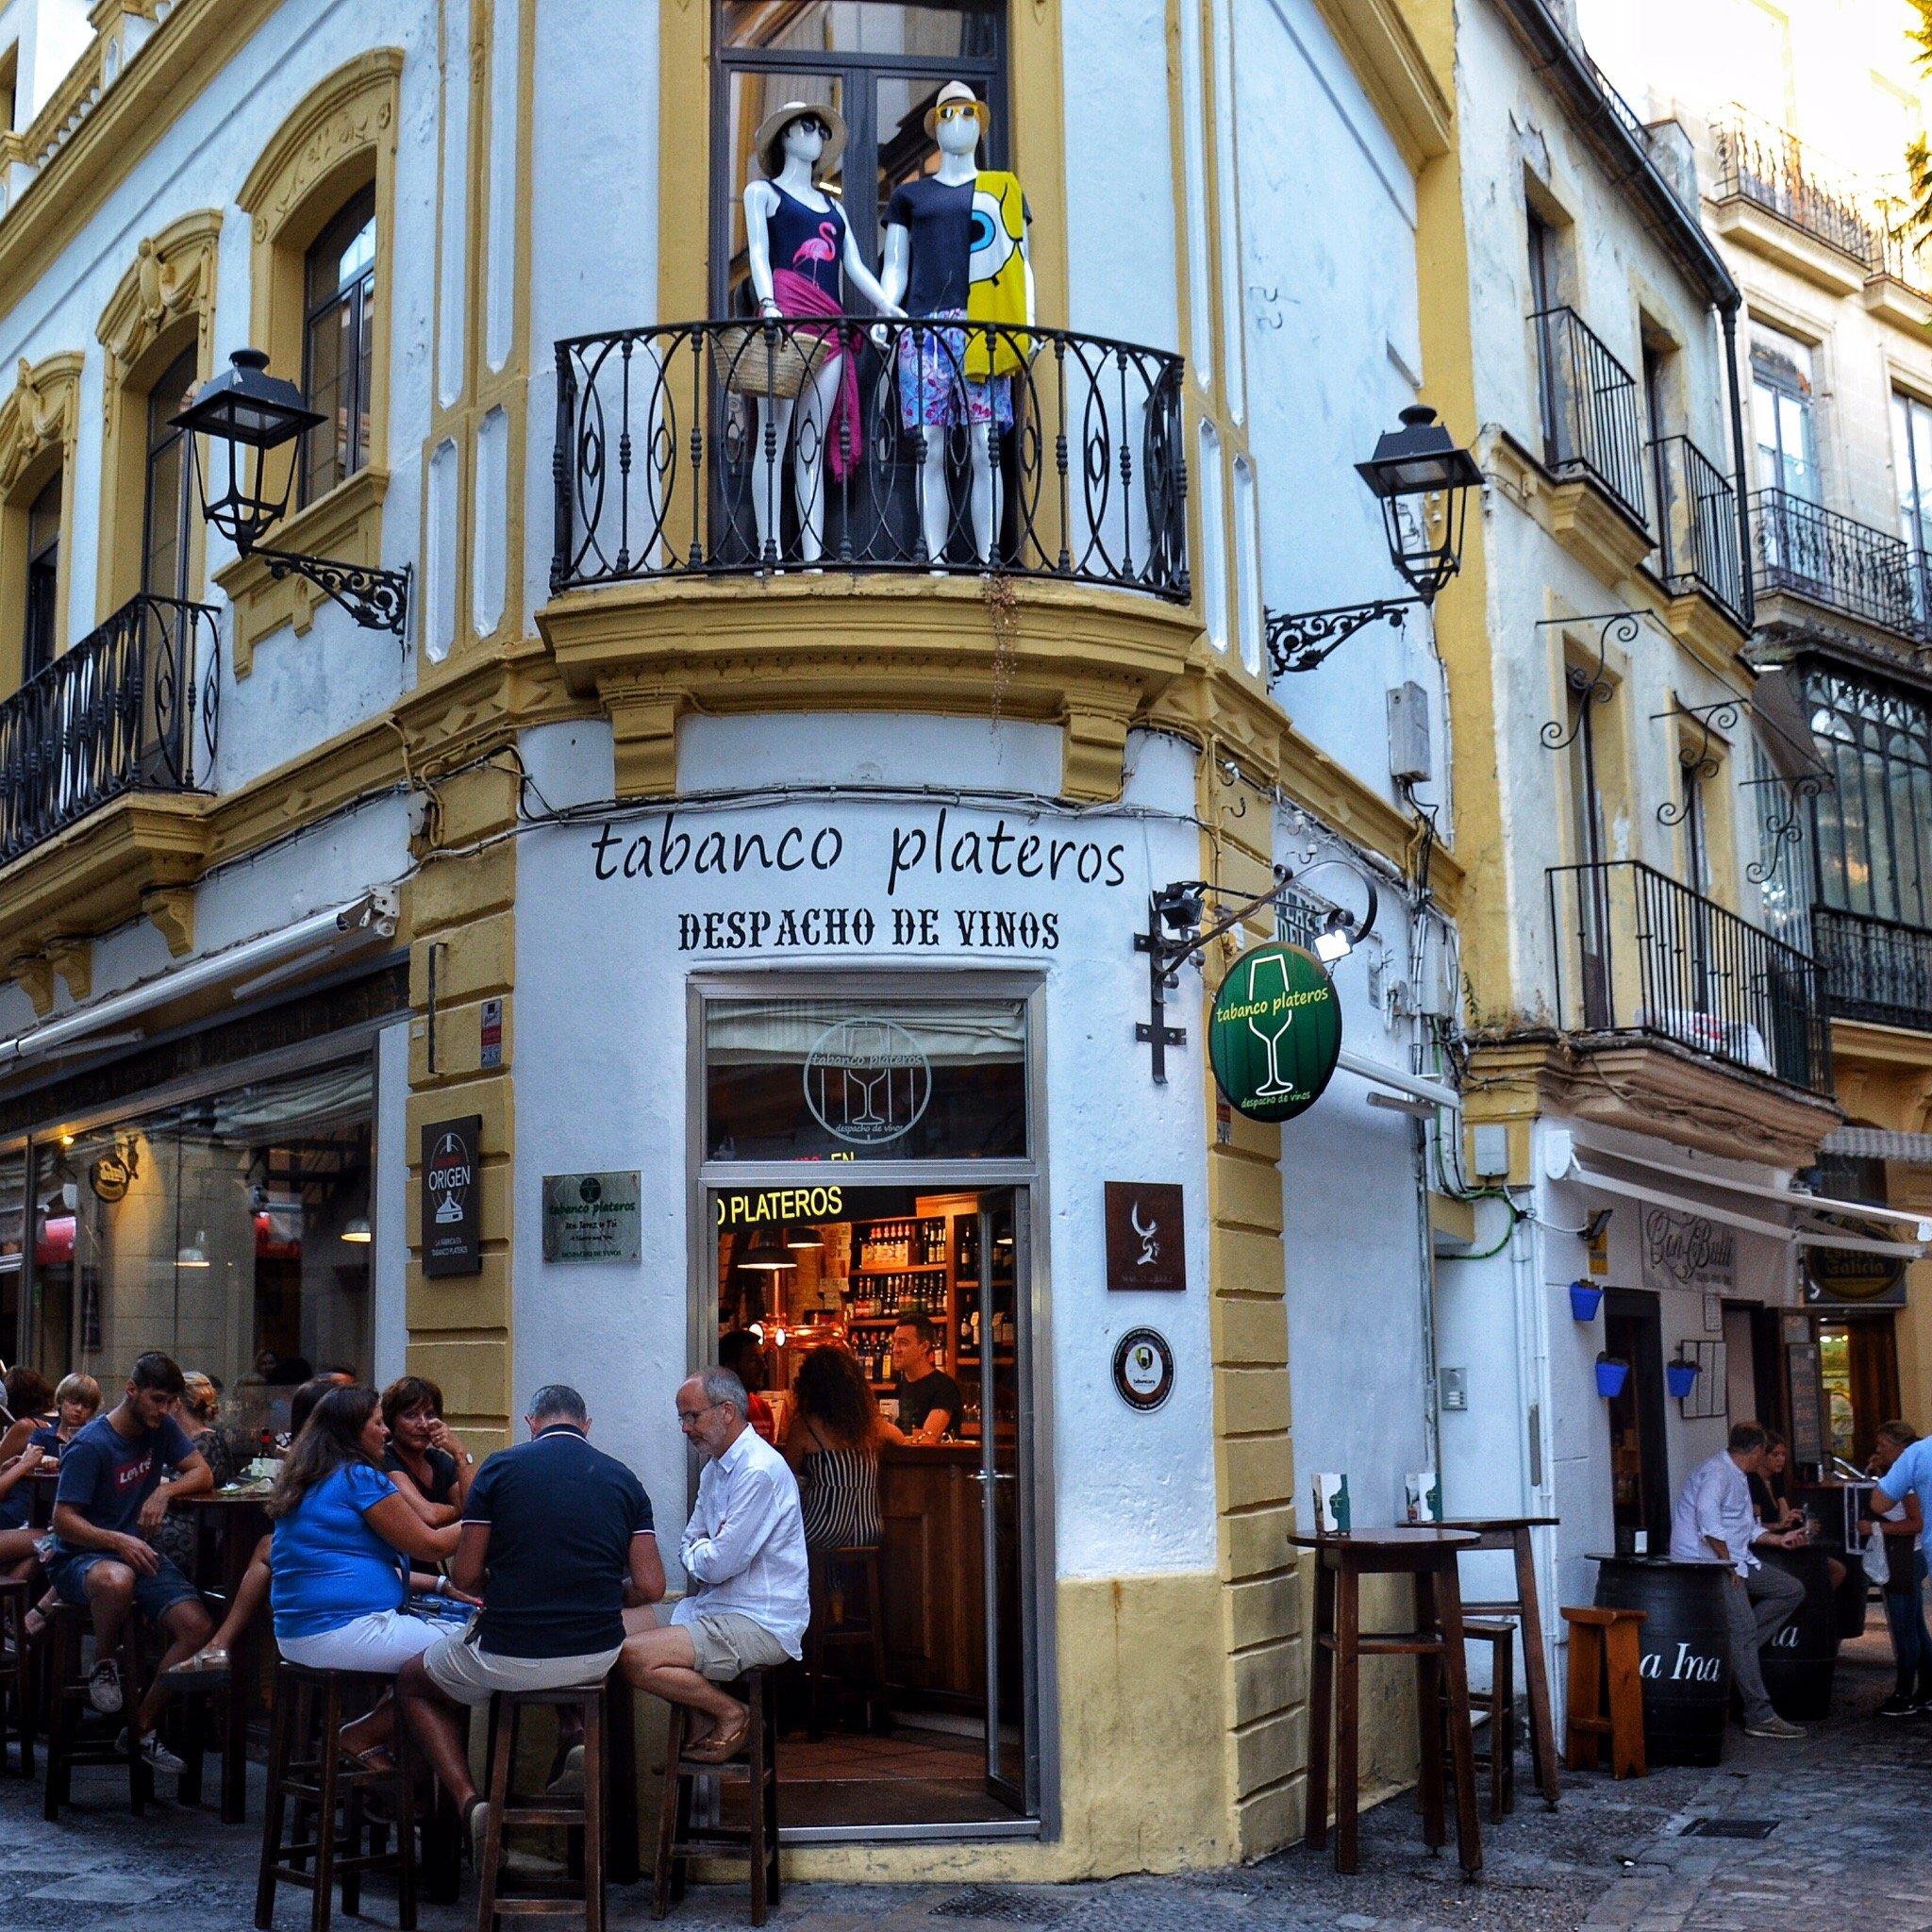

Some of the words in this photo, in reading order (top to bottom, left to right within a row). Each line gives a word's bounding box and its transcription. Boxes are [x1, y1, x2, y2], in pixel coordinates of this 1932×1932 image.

[591, 811, 843, 881] tabanco
[887, 808, 1126, 894] plateros
[677, 908, 875, 951] DESPACHO
[891, 908, 940, 946] DE
[954, 909, 1059, 950] VINOS
[1216, 1000, 1268, 1023] tabanco
[1273, 987, 1328, 1016] plateros
[812, 1052, 865, 1066] tabanco
[869, 1054, 923, 1070] plateros
[1241, 1094, 1275, 1109] despacho
[1277, 1092, 1289, 1104] de
[1291, 1091, 1310, 1103] vinos
[835, 1124, 870, 1134] despacho
[872, 1123, 882, 1132] de
[884, 1124, 904, 1132] vinos
[428, 1165, 471, 1191] ORIGEN
[592, 1199, 636, 1216] plateros
[730, 1186, 843, 1224] PLATEROS
[1639, 1653, 1663, 1679] a
[1670, 1641, 1722, 1682] Ina
